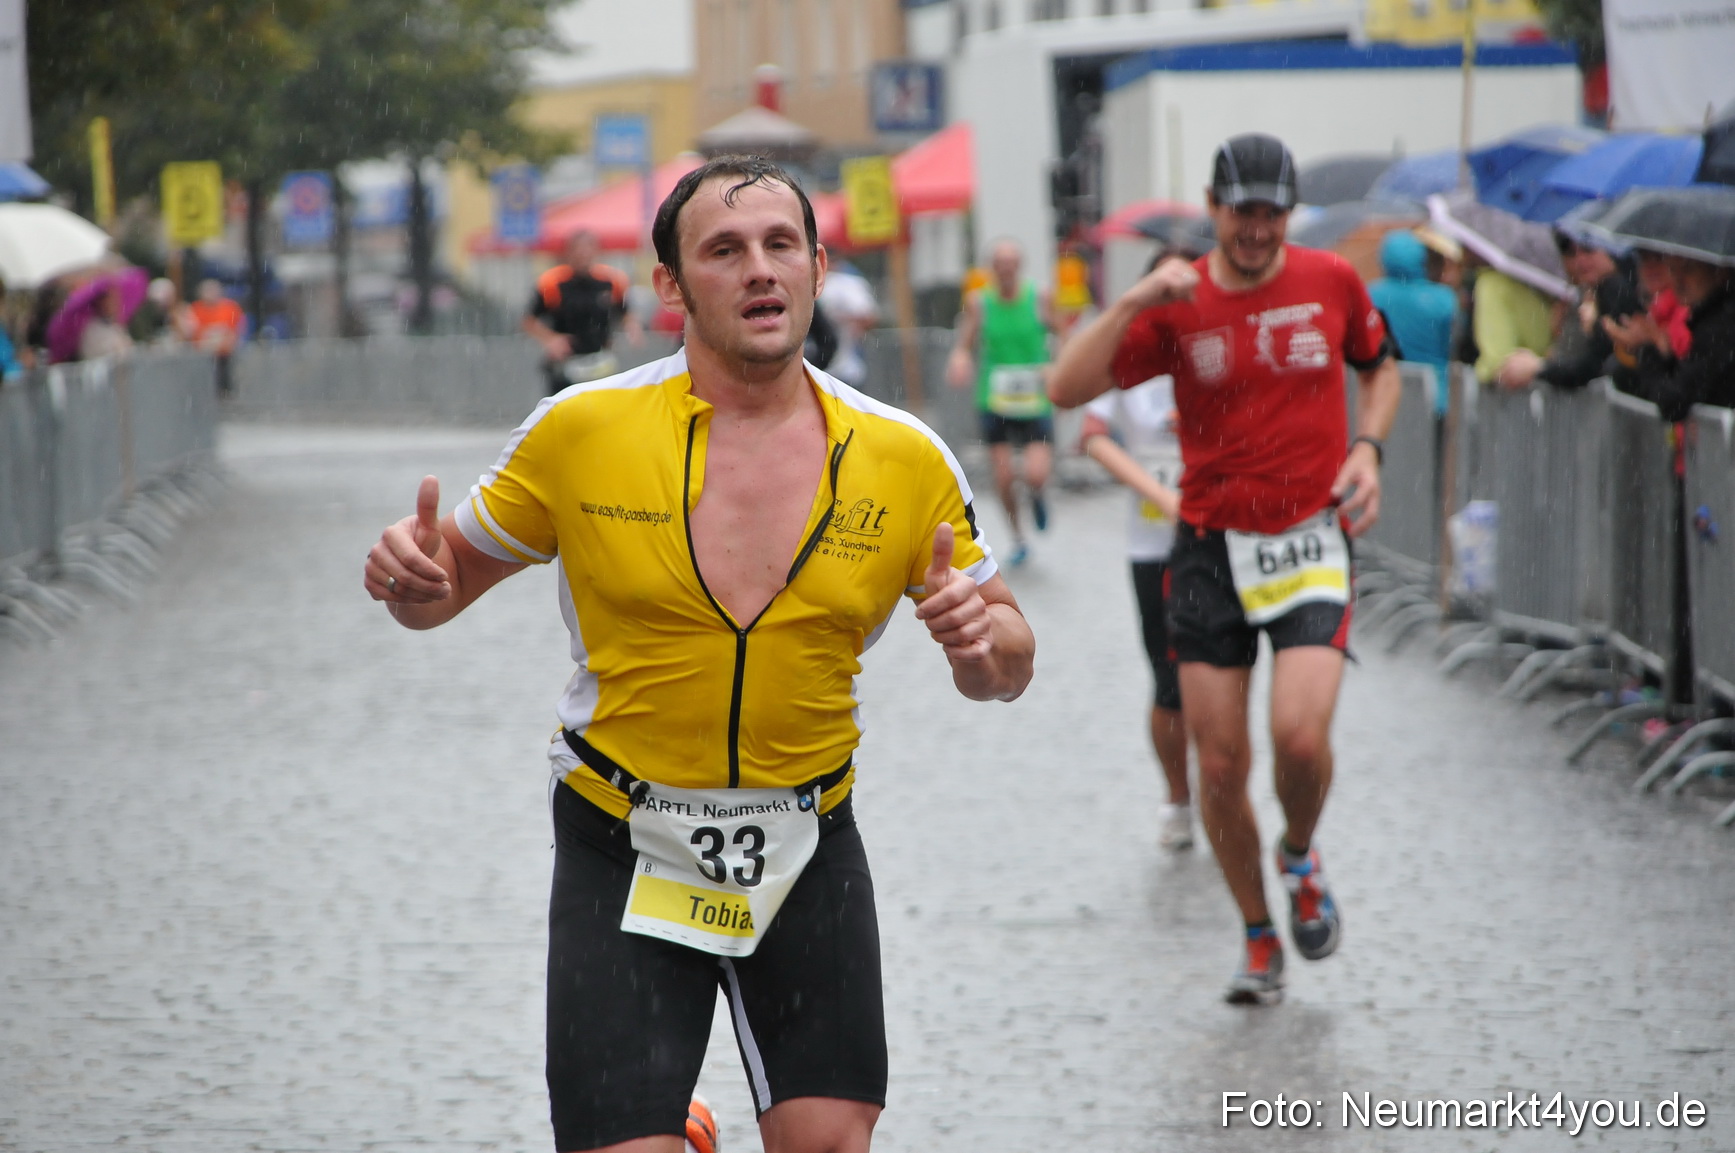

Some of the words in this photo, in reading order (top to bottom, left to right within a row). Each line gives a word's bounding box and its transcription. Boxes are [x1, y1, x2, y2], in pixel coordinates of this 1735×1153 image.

[580, 502, 672, 526] www.easyfit-parsberg.de
[839, 538, 881, 554] Xundheit
[1256, 532, 1322, 575] 640
[703, 799, 791, 818] Neumarkt
[690, 824, 766, 887] 33
[689, 895, 755, 930] Tobia
